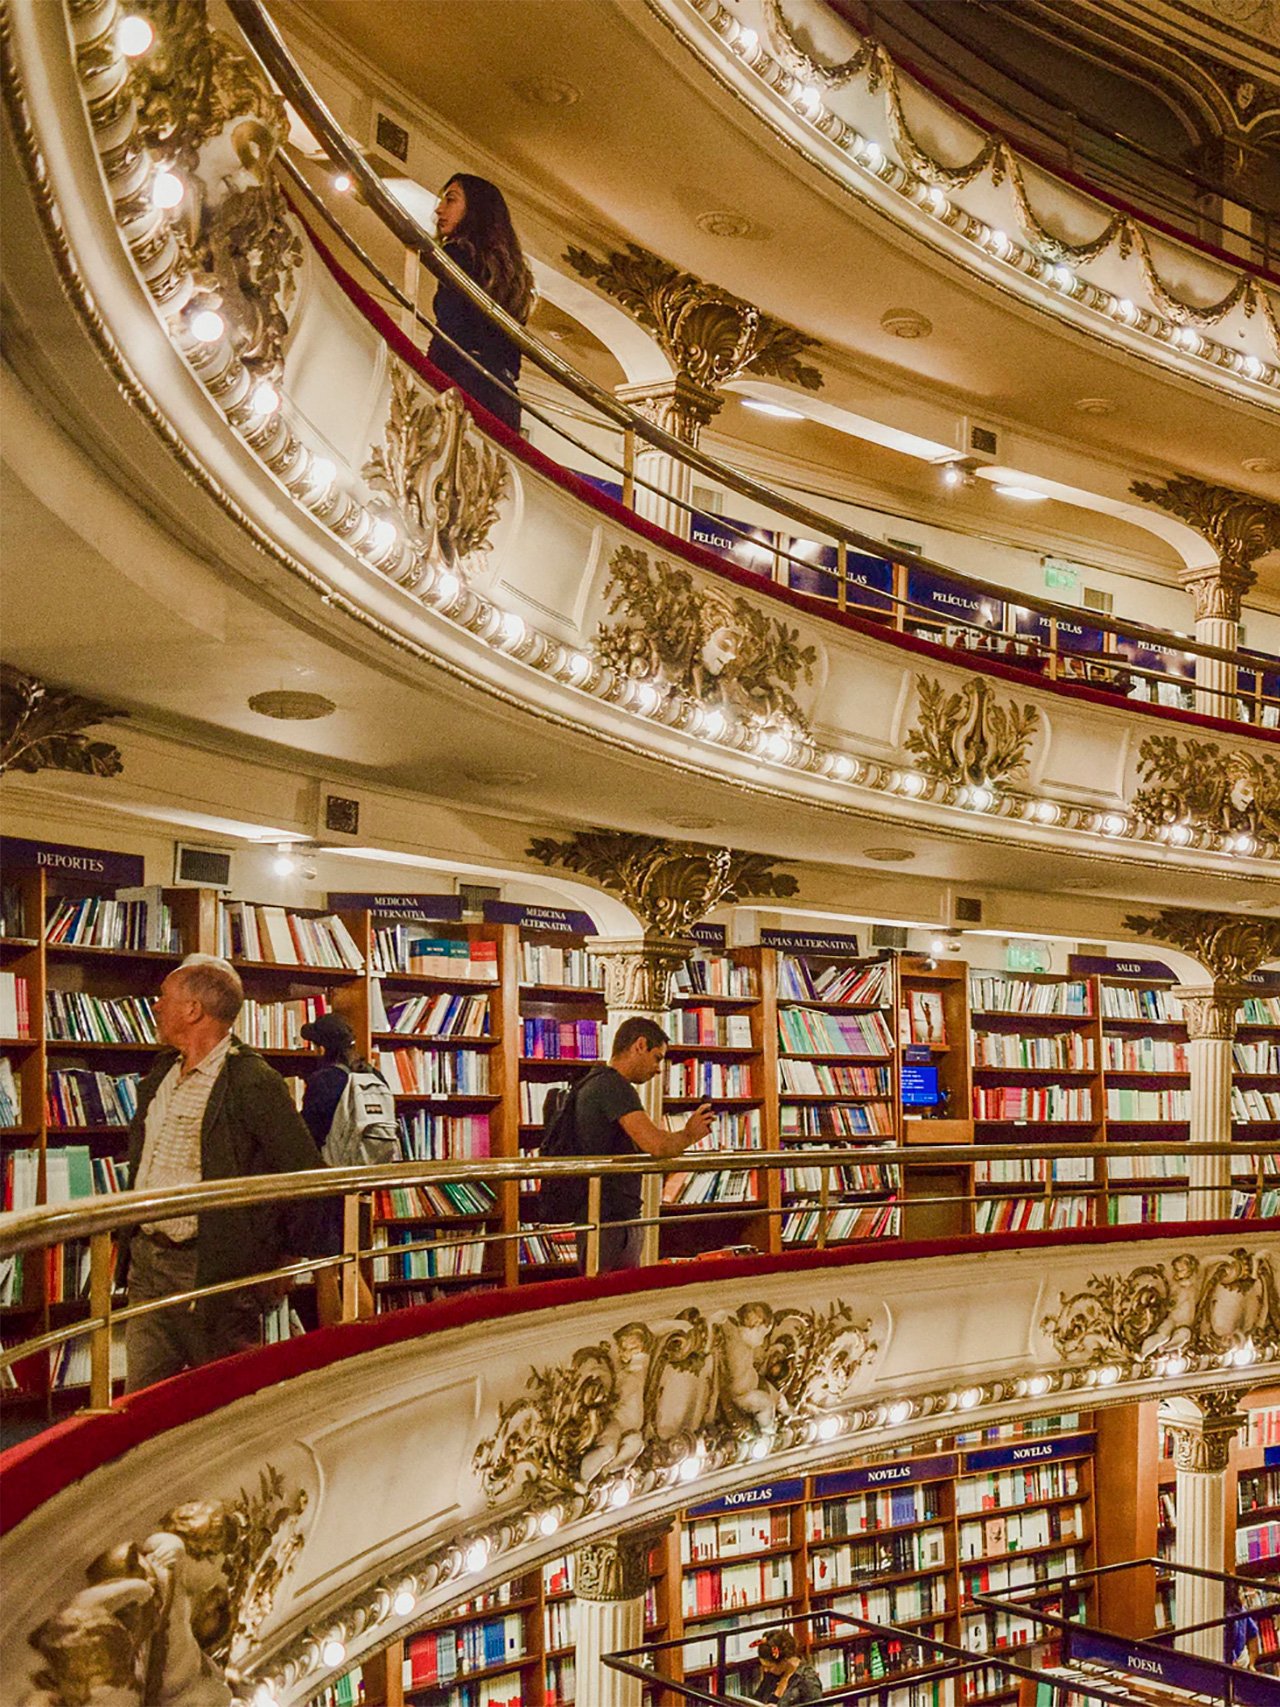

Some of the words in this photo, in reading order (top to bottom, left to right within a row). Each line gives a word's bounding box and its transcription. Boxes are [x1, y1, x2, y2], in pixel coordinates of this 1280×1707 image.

[693, 530, 737, 551] PELÍCUL
[932, 590, 980, 611] PELÍCULAS
[1039, 616, 1083, 636] PELCULAS
[37, 851, 104, 873] DEPORTES
[374, 896, 418, 906] MEDICINA
[526, 907, 567, 920] MEDICINA
[520, 918, 573, 932] ALTERNATIVA
[761, 936, 793, 947] RAPIAS
[794, 938, 857, 951] ALTERNATIVA
[1116, 963, 1141, 973] SALUD
[1013, 1444, 1053, 1459] NOVELAS
[867, 1466, 911, 1482] NOVELAS
[724, 1488, 773, 1506] NOVELAS
[1127, 1655, 1163, 1676] POESIA
